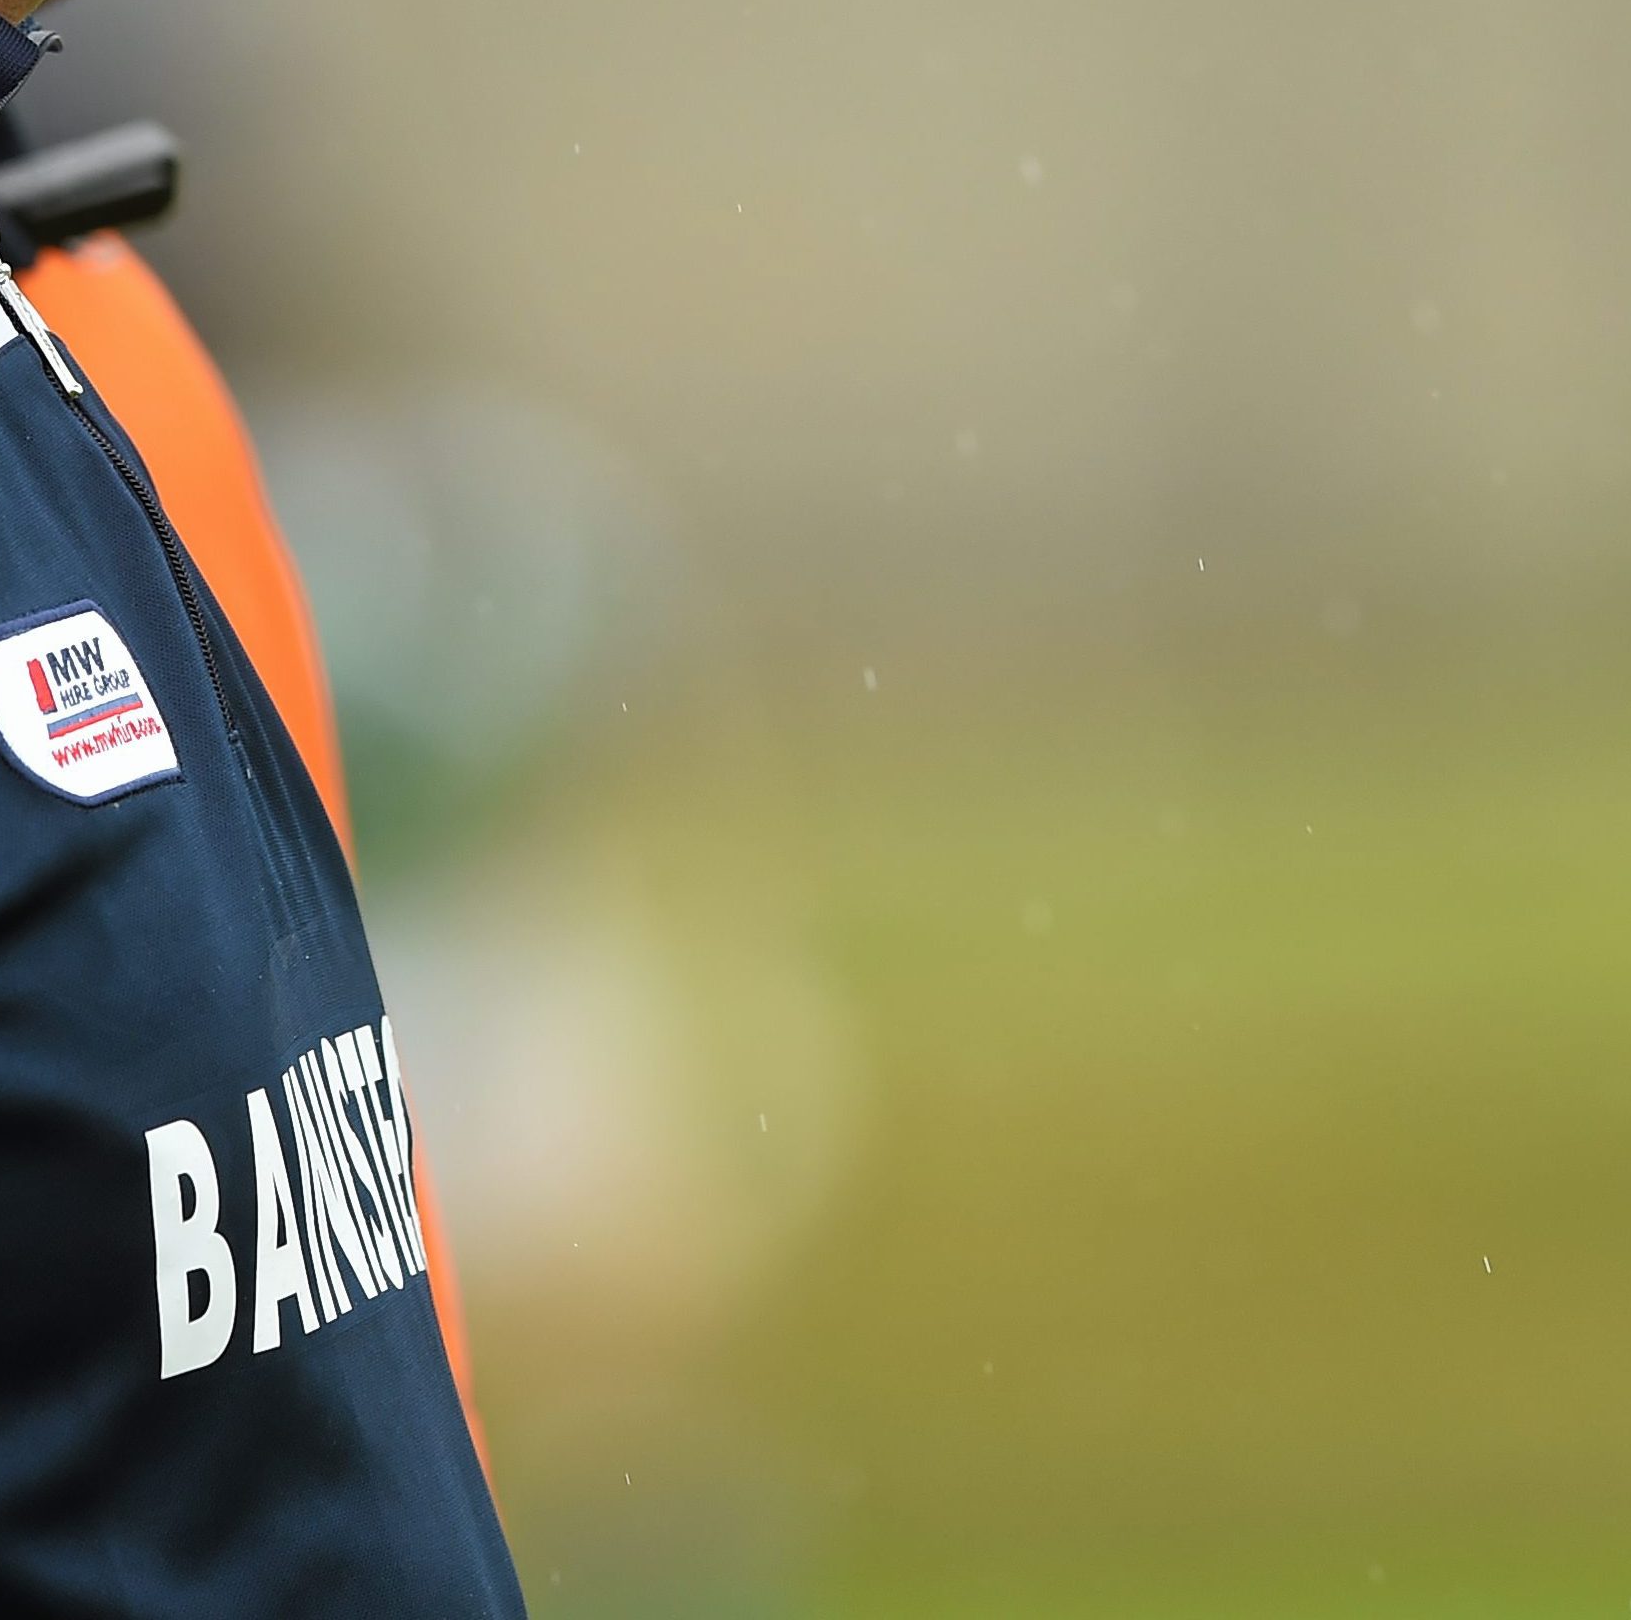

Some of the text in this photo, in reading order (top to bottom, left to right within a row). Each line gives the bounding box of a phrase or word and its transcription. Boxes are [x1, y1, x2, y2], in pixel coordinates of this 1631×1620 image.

[46, 636, 104, 687] MW
[60, 668, 131, 709] HIRE GROUP
